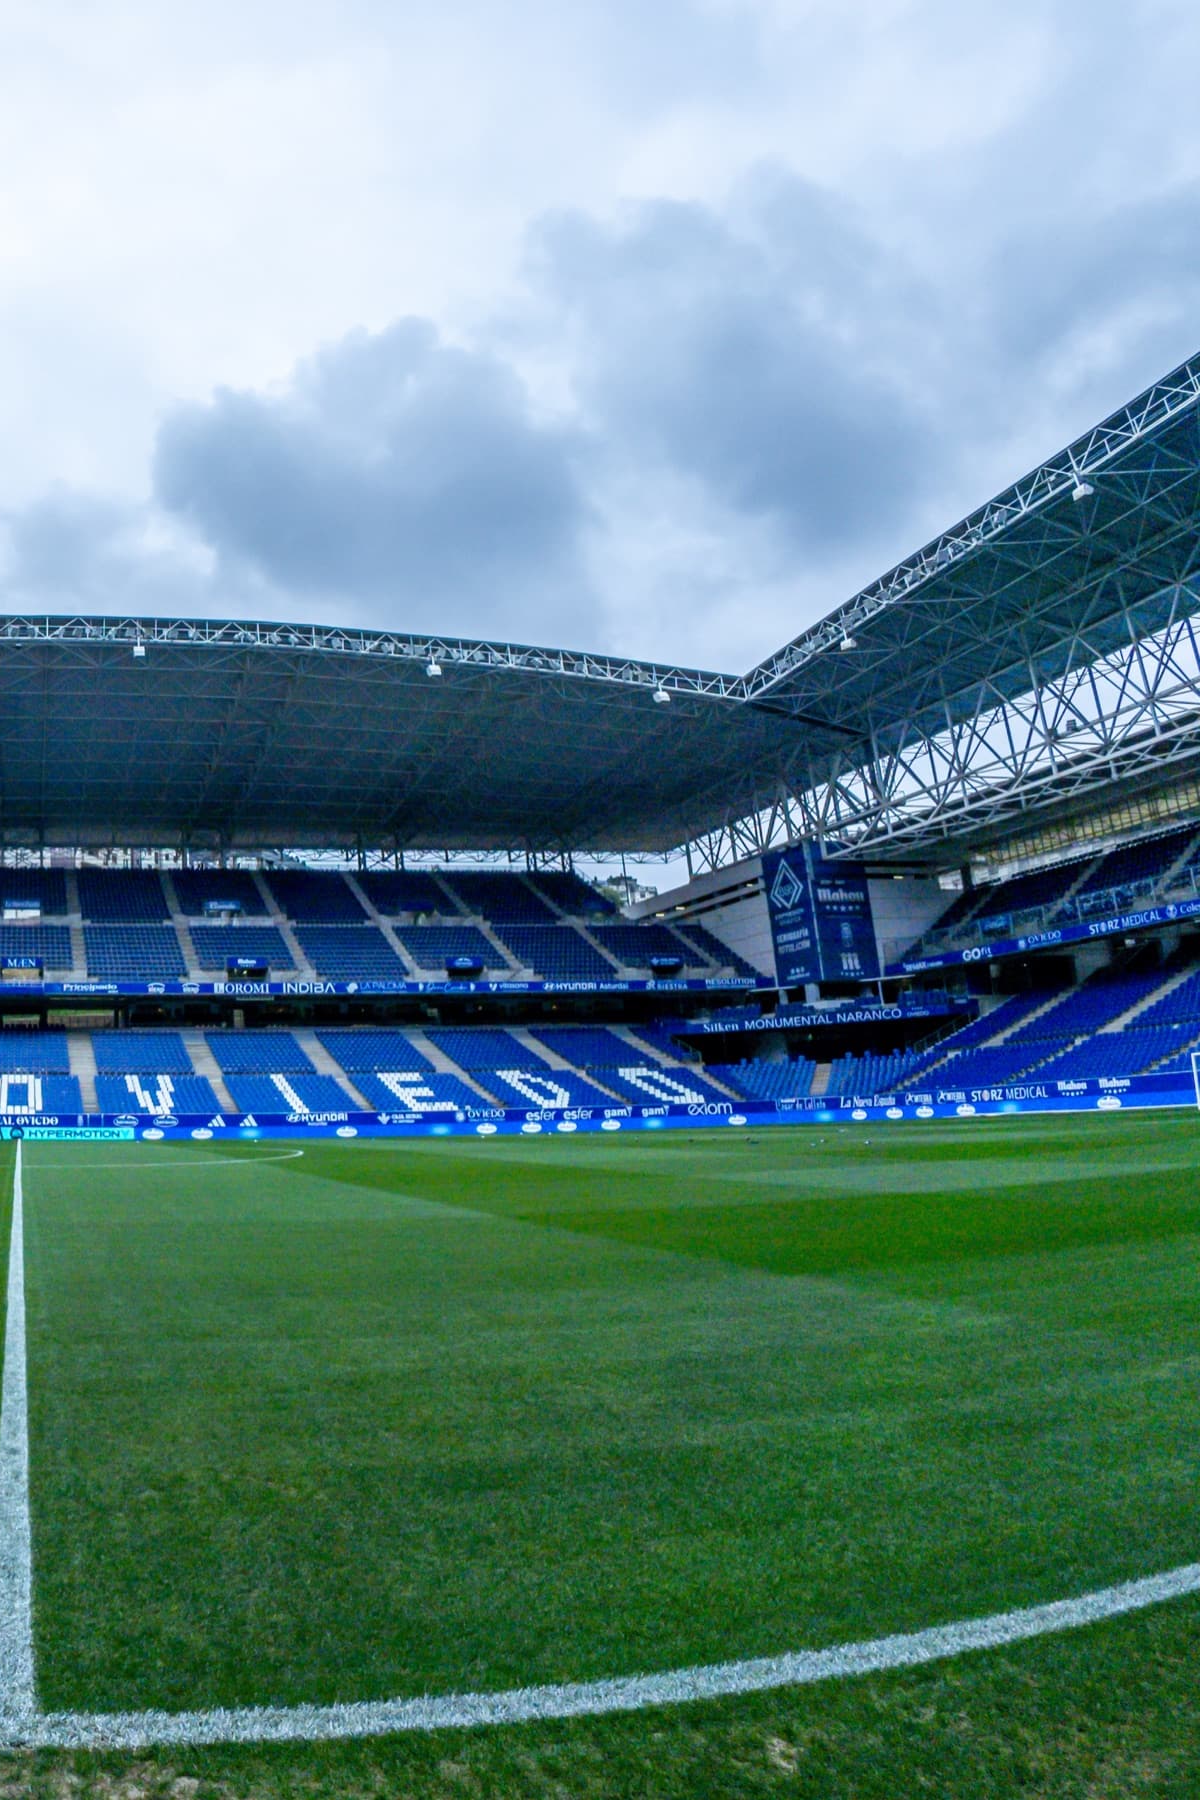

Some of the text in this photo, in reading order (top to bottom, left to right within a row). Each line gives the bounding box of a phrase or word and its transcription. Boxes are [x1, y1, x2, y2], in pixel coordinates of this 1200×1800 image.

[1121, 910, 1162, 928] MEDICAL
[283, 982, 337, 994] INDIBA
[556, 982, 597, 991] HYUNDAI
[703, 1008, 902, 1033] Silken MONUMENTAL NARANCO
[1057, 1080, 1087, 1091] Mahou
[1098, 1078, 1131, 1089] Mahou
[1005, 1086, 1048, 1100] MEDICAL
[840, 1095, 851, 1108] La
[467, 1108, 506, 1119] OVIEDO
[525, 1108, 557, 1122] esfer
[563, 1107, 593, 1120] esfer
[688, 1102, 734, 1116] exiom
[16, 1115, 59, 1126] OVIEDO
[301, 1112, 349, 1122] HYUNDAI
[28, 1129, 121, 1139] HYPERMOTION
